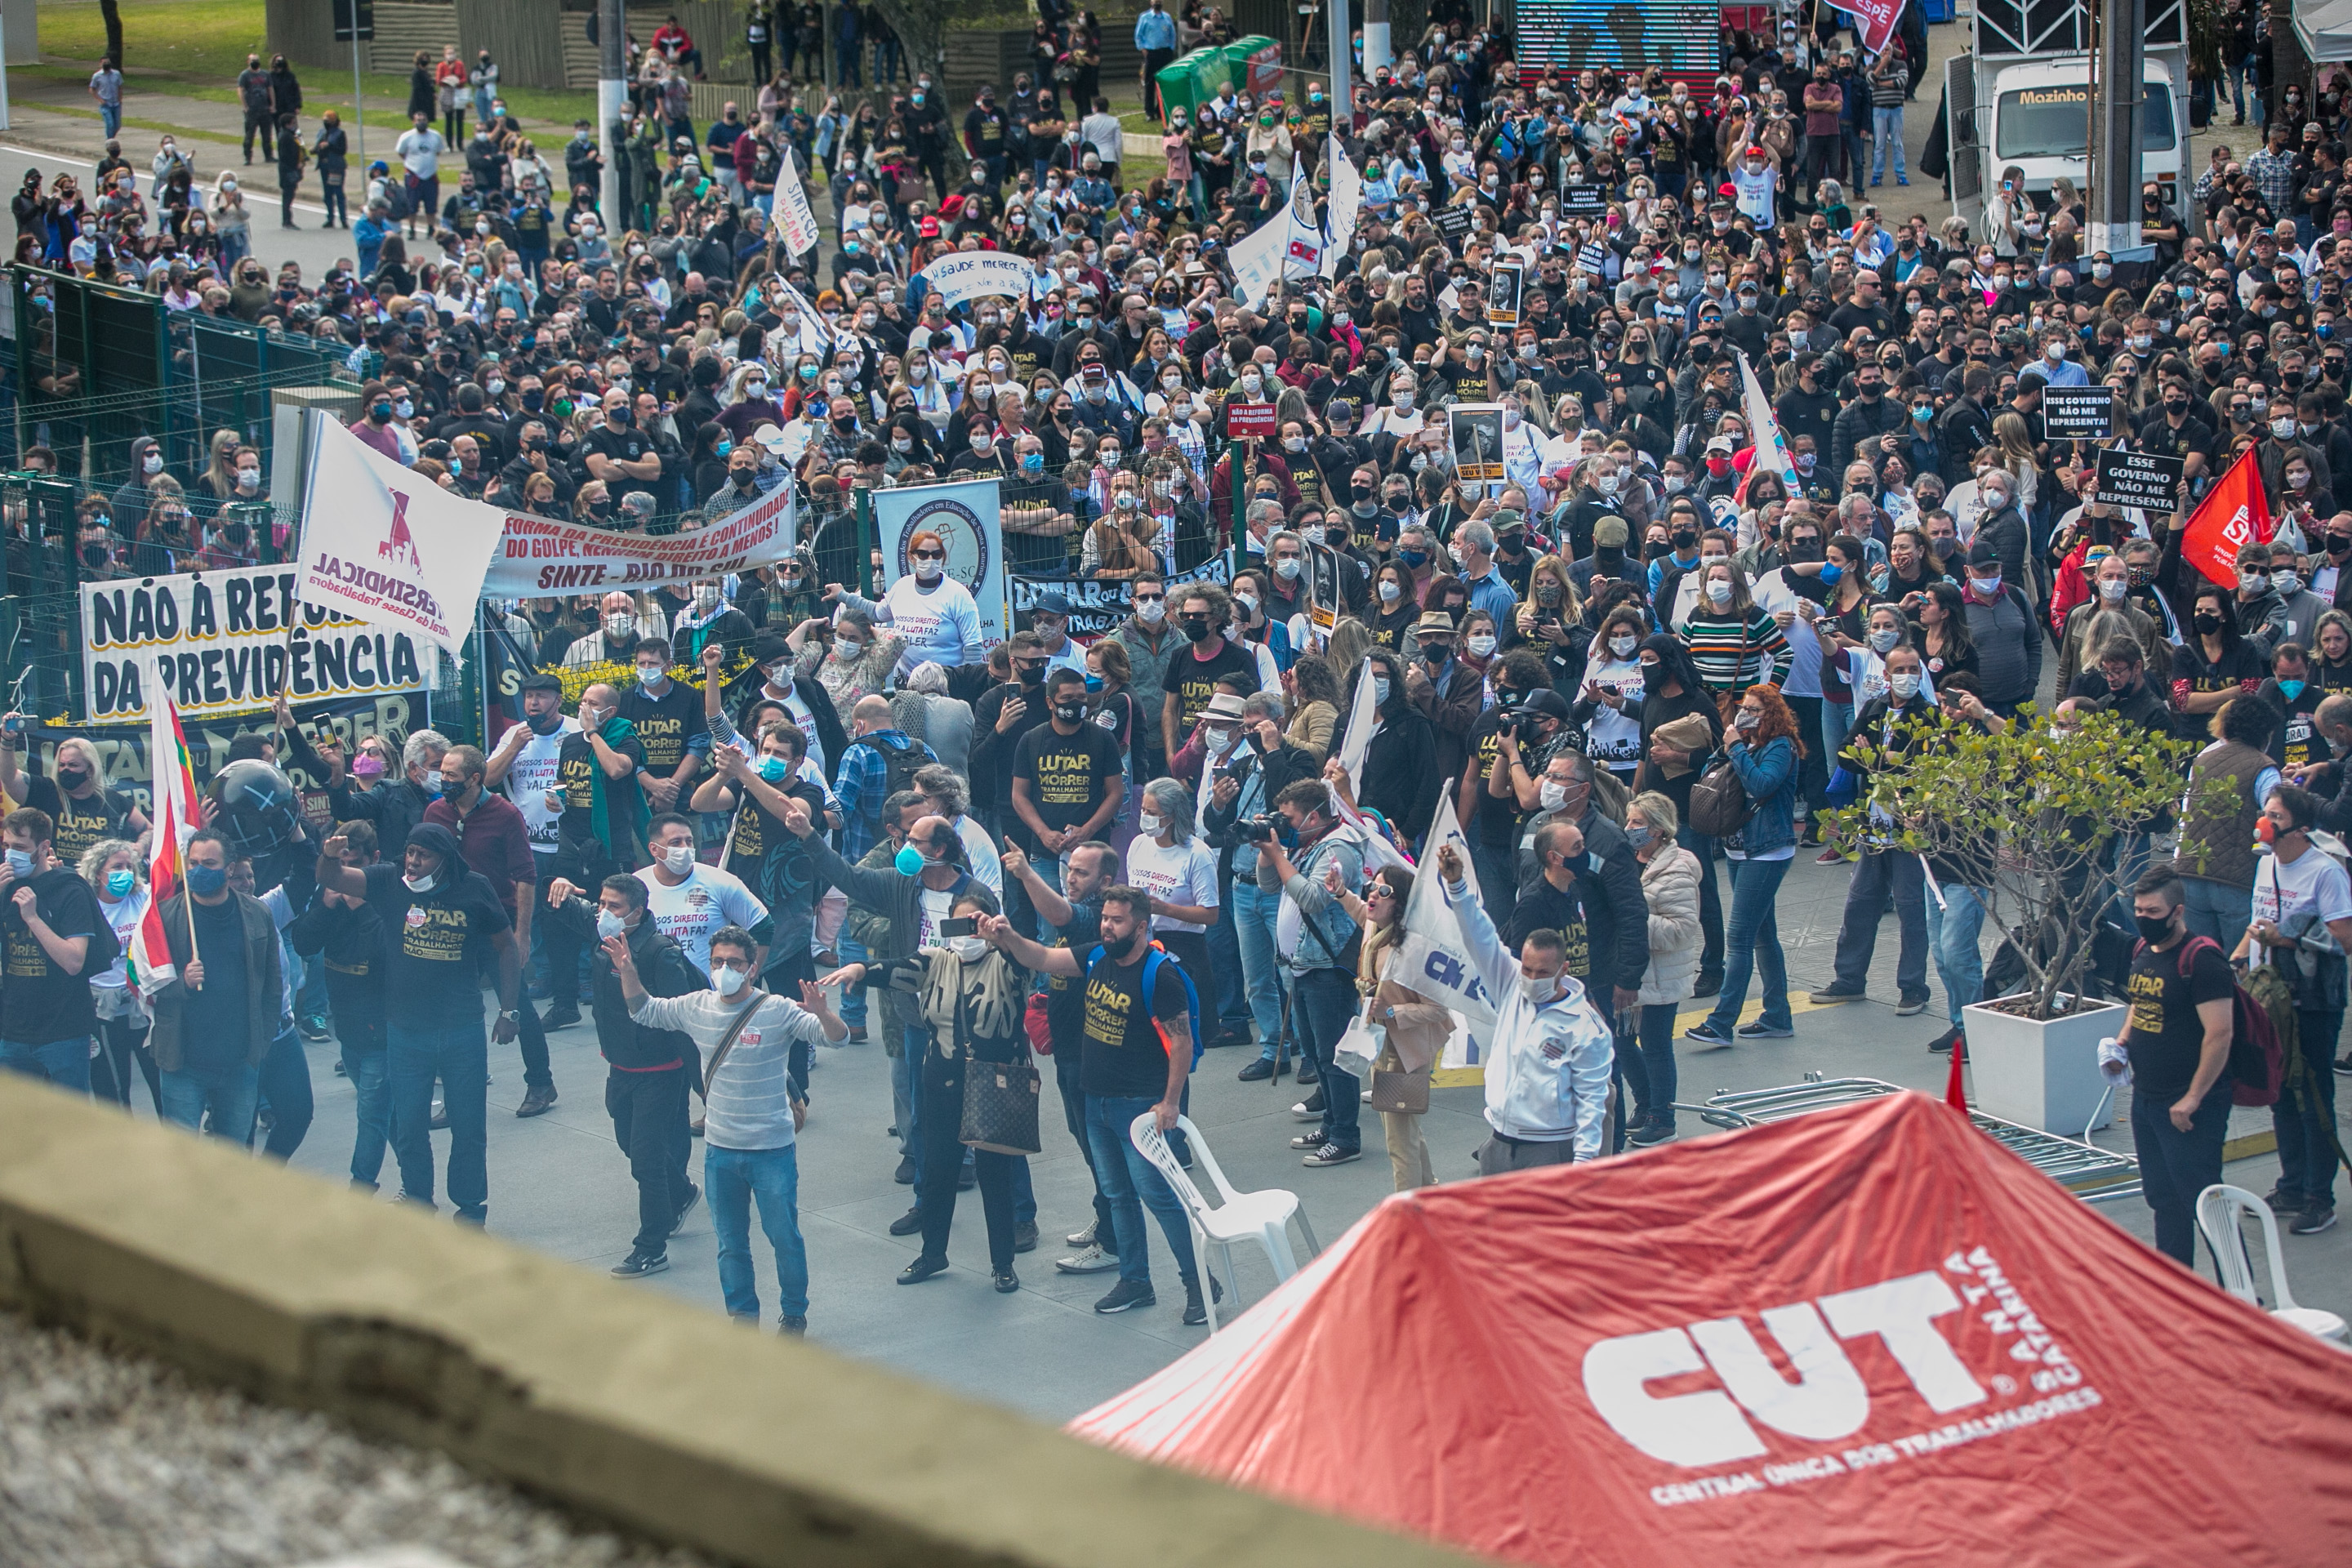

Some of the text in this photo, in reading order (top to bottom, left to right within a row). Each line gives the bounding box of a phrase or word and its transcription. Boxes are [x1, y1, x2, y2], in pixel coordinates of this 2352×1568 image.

[2020, 89, 2087, 105] Mazinho
[1444, 211, 1459, 219] DEFESA
[1457, 379, 1488, 388] LUTAR
[2065, 396, 2111, 404] GOVERNO
[2059, 406, 2079, 416] NÃO
[2049, 417, 2108, 425] REPRESENTA!
[2127, 457, 2155, 469] ESSE
[2109, 467, 2171, 483] GOVERNO
[2114, 480, 2166, 496] NÃO ME
[2098, 492, 2174, 509] REPRESENTA
[946, 501, 972, 519] Educação
[563, 528, 589, 541] DA
[589, 533, 697, 552] PREVIDÊNCIA
[699, 532, 709, 549] É
[710, 488, 790, 546] CONTINUIDADE
[506, 538, 528, 558] DO
[582, 543, 653, 559] NENHUM
[654, 547, 719, 563] DIREITO
[718, 544, 730, 560] A
[538, 564, 608, 589] SINTE
[93, 578, 179, 646] NÃO
[915, 617, 939, 626] DIREITOS
[906, 625, 924, 634] LUTA
[924, 626, 938, 636] FAZ
[905, 635, 928, 648] ALER
[95, 627, 421, 715] DA PREVIDÊNCIA
[1039, 755, 1091, 771] LUTAR
[528, 768, 534, 778] A
[535, 768, 555, 777] LUTA
[1039, 773, 1090, 786] MORRER
[1157, 885, 1173, 897] FAZ
[674, 915, 709, 923] DIREITOS
[403, 921, 466, 942] MORRER
[690, 926, 708, 937] FAZ
[1438, 943, 1458, 957] Filiada
[1086, 978, 1131, 1013] LUTAR
[1085, 999, 1129, 1028] MORRER
[1944, 1250, 2060, 1392] SANTA
[1967, 1245, 2082, 1386] CATARINA
[1583, 1270, 1989, 1468] CUT
[1650, 1471, 1766, 1507] CENTRAL
[1841, 1442, 1899, 1470] DOS
[1892, 1386, 2103, 1457] TRABALHADORES
